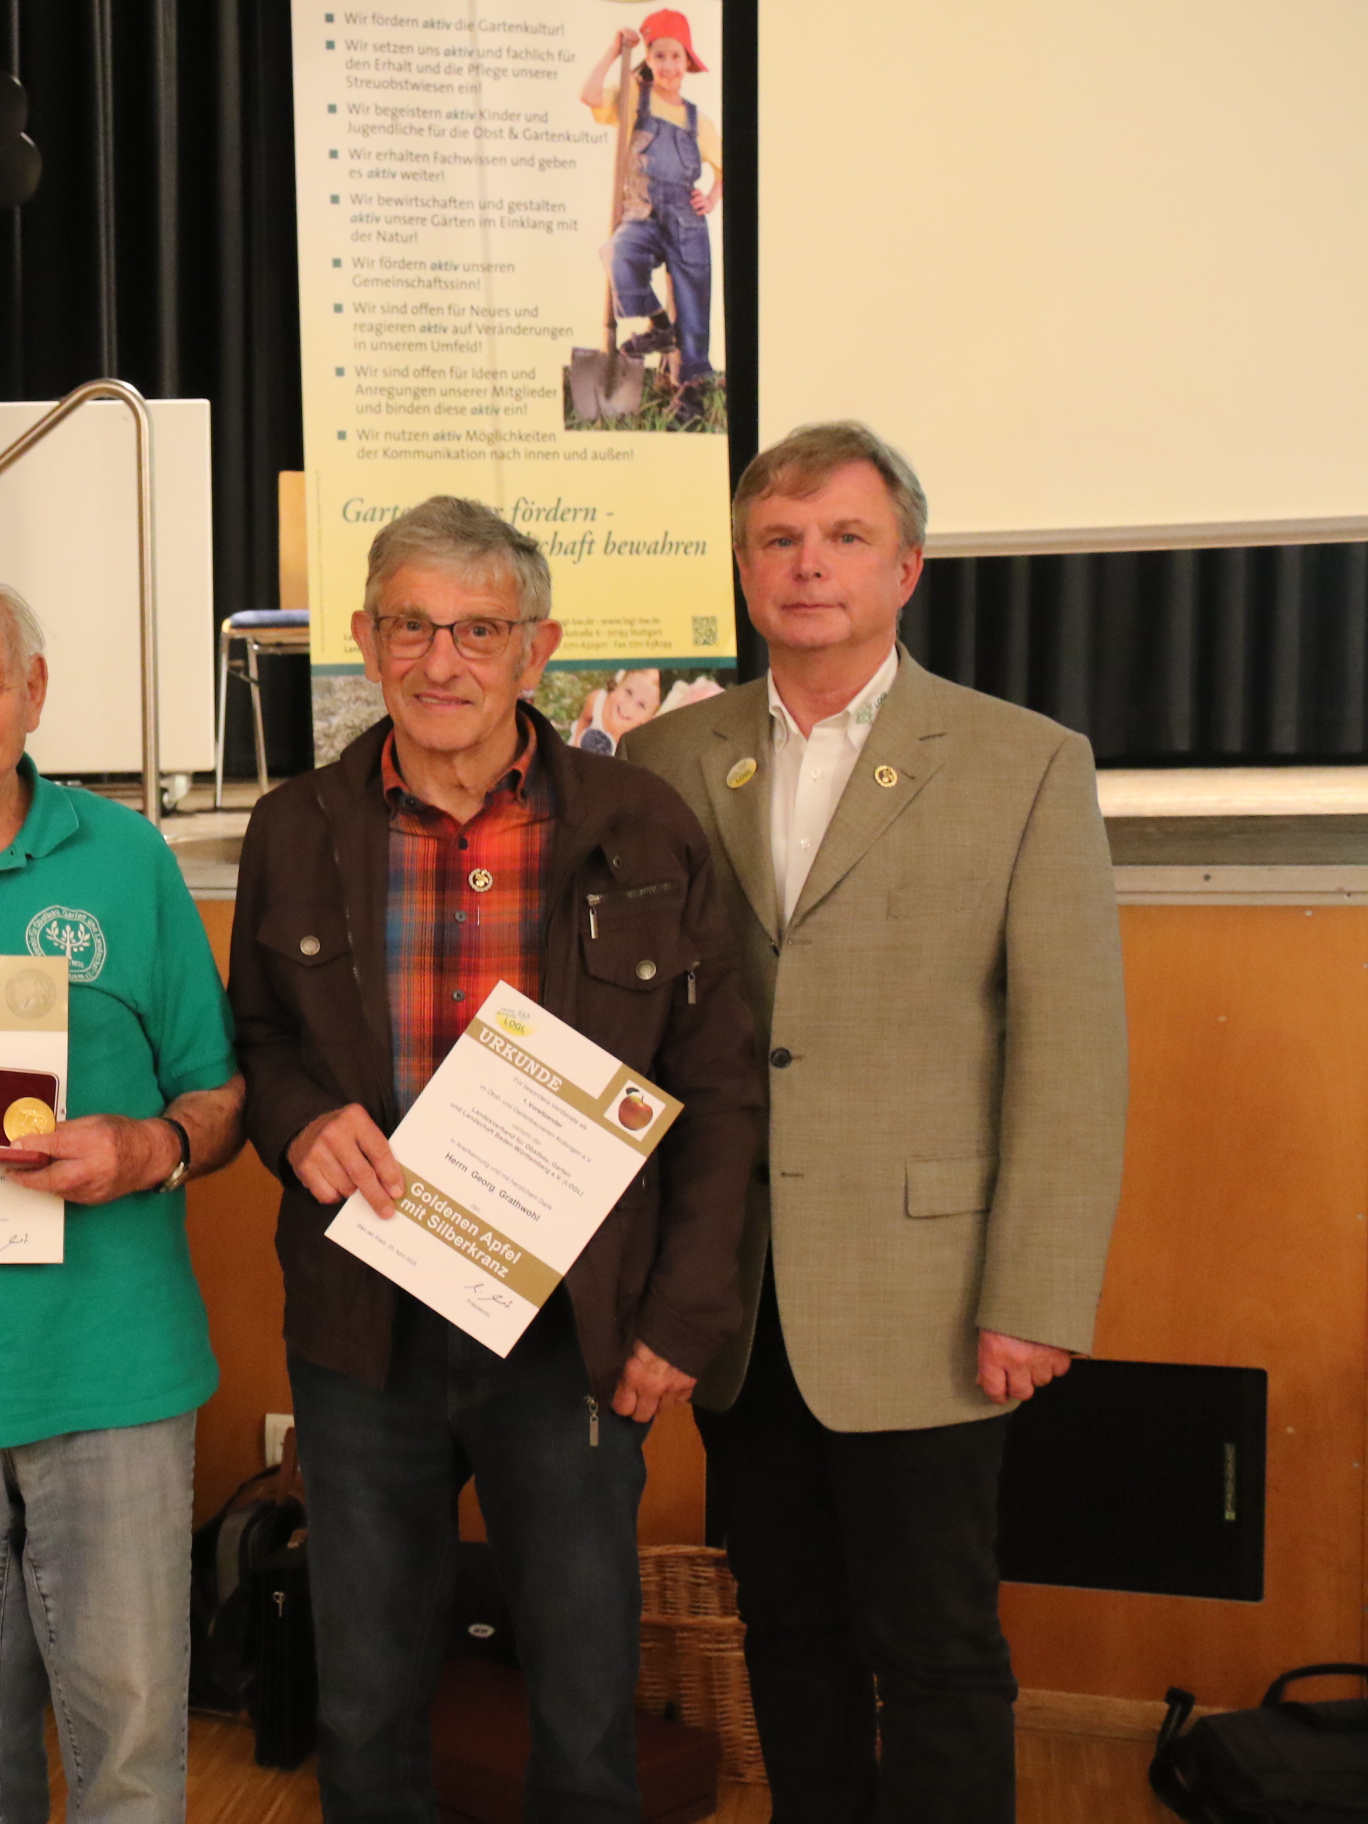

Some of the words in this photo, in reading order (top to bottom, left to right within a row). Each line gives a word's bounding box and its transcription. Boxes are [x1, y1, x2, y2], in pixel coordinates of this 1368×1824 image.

[343, 12, 367, 24] Wir
[421, 17, 452, 30] aktiv
[454, 18, 474, 32] die
[477, 19, 564, 36] Gartenkultur!
[344, 39, 368, 51] Wir
[372, 41, 414, 54] setzen
[417, 46, 440, 56] uns
[443, 45, 474, 57] aktiv
[477, 46, 503, 59] und
[506, 45, 554, 61] fachlich
[344, 57, 370, 70] den
[374, 58, 412, 73] Erhalt
[416, 62, 440, 74] und
[443, 62, 463, 76] die
[467, 63, 508, 81] Pflege
[511, 68, 558, 80] unserer
[345, 75, 454, 93] Streuobstwiesen
[457, 82, 481, 94] ein!
[346, 102, 370, 115] Wir
[374, 103, 442, 120] begeistern
[445, 108, 476, 120] aktiv
[479, 109, 521, 122] Kinder
[524, 111, 548, 123] und
[347, 121, 425, 138] Jugendliche
[449, 126, 469, 139] die
[472, 126, 503, 139] Obst
[522, 127, 607, 143] Gartenkultur!
[348, 147, 372, 160] Wir
[375, 148, 430, 163] erhalten
[433, 151, 507, 166] Fachwissen
[510, 155, 535, 167] und
[538, 156, 576, 172] geben
[348, 169, 363, 178] es
[366, 167, 397, 179] aktiv
[400, 169, 444, 182] weiter!
[349, 193, 373, 205] Wir
[377, 193, 474, 209] bewirtschaften
[478, 198, 504, 210] und
[507, 199, 566, 214] gestalten
[350, 212, 381, 224] aktiv
[384, 215, 427, 226] unsere
[479, 216, 496, 228] im
[499, 215, 554, 234] Einklang
[556, 219, 577, 231] mit
[350, 229, 372, 242] der
[376, 230, 418, 243] Natur!
[351, 256, 375, 268] Wir
[429, 259, 459, 271] aktiv
[462, 263, 515, 273] unseren
[351, 274, 480, 290] Gemeinschaftssinn!
[352, 302, 376, 313] Wir
[380, 301, 407, 315] sind
[410, 302, 444, 316] offen
[470, 304, 510, 317] Neues
[514, 305, 538, 318] und
[353, 320, 416, 336] reagieren
[419, 322, 449, 334] aktiv
[451, 321, 472, 335] auf
[354, 340, 366, 350] in
[370, 341, 427, 352] unserem
[430, 339, 482, 353] Umfeld!
[354, 365, 378, 377] Wir
[382, 365, 409, 378] sind
[412, 365, 446, 379] offen
[471, 367, 507, 380] Ideen
[511, 367, 536, 380] und
[355, 383, 436, 400] Anregungen
[440, 387, 487, 398] unserer
[491, 385, 557, 401] Mitglieder
[355, 401, 381, 414] und
[385, 401, 430, 414] binden
[433, 402, 467, 416] diese
[470, 403, 500, 415] aktiv
[503, 403, 527, 416] ein!
[356, 429, 380, 441] Wir
[384, 429, 429, 441] nutzen
[432, 429, 462, 442] aktiv
[356, 446, 379, 459] der
[382, 447, 486, 460] Kommunikation
[490, 447, 520, 460] nach
[524, 448, 560, 460] innen
[563, 448, 587, 460] und
[511, 497, 597, 526] fördern
[603, 531, 707, 556] bewahren
[479, 1026, 562, 1092] URKUNDE
[444, 1152, 468, 1172] Herrn
[470, 1170, 496, 1193] Georg
[498, 1189, 540, 1222] Grathwohl
[410, 1178, 479, 1236] Goldenen
[479, 1231, 522, 1264] Apfel
[400, 1198, 426, 1221] mit
[427, 1214, 509, 1278] Silberkranz
